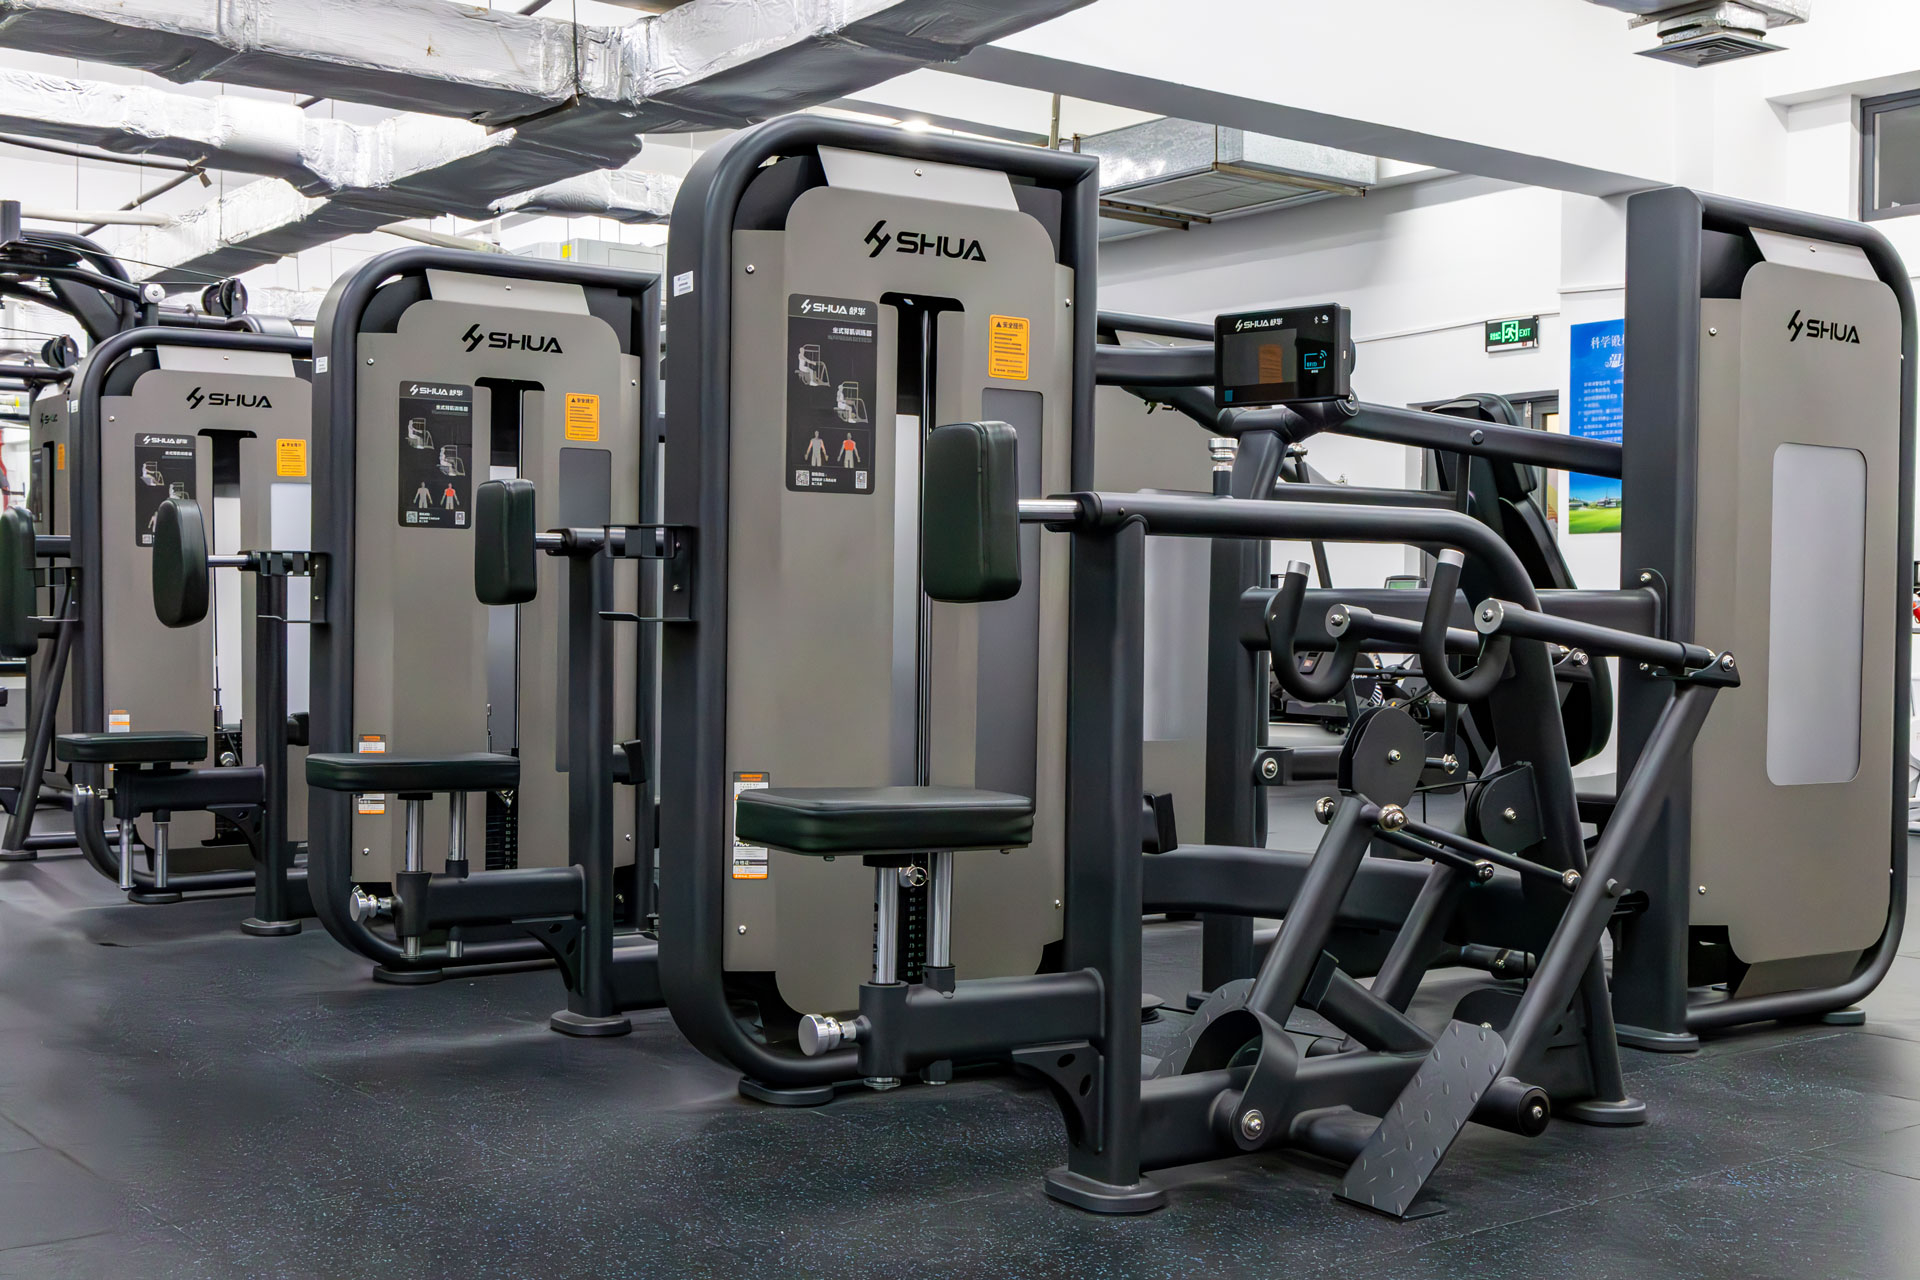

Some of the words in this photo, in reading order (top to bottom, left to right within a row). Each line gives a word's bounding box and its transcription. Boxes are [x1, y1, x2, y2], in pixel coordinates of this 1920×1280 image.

[895, 231, 987, 263] SHUA
[813, 302, 848, 315] SHUA
[1243, 319, 1269, 329] SHUA
[1806, 318, 1860, 344] SHUA
[488, 331, 564, 354] SHUA
[419, 387, 448, 396] SHUA
[208, 392, 273, 409] SHUA
